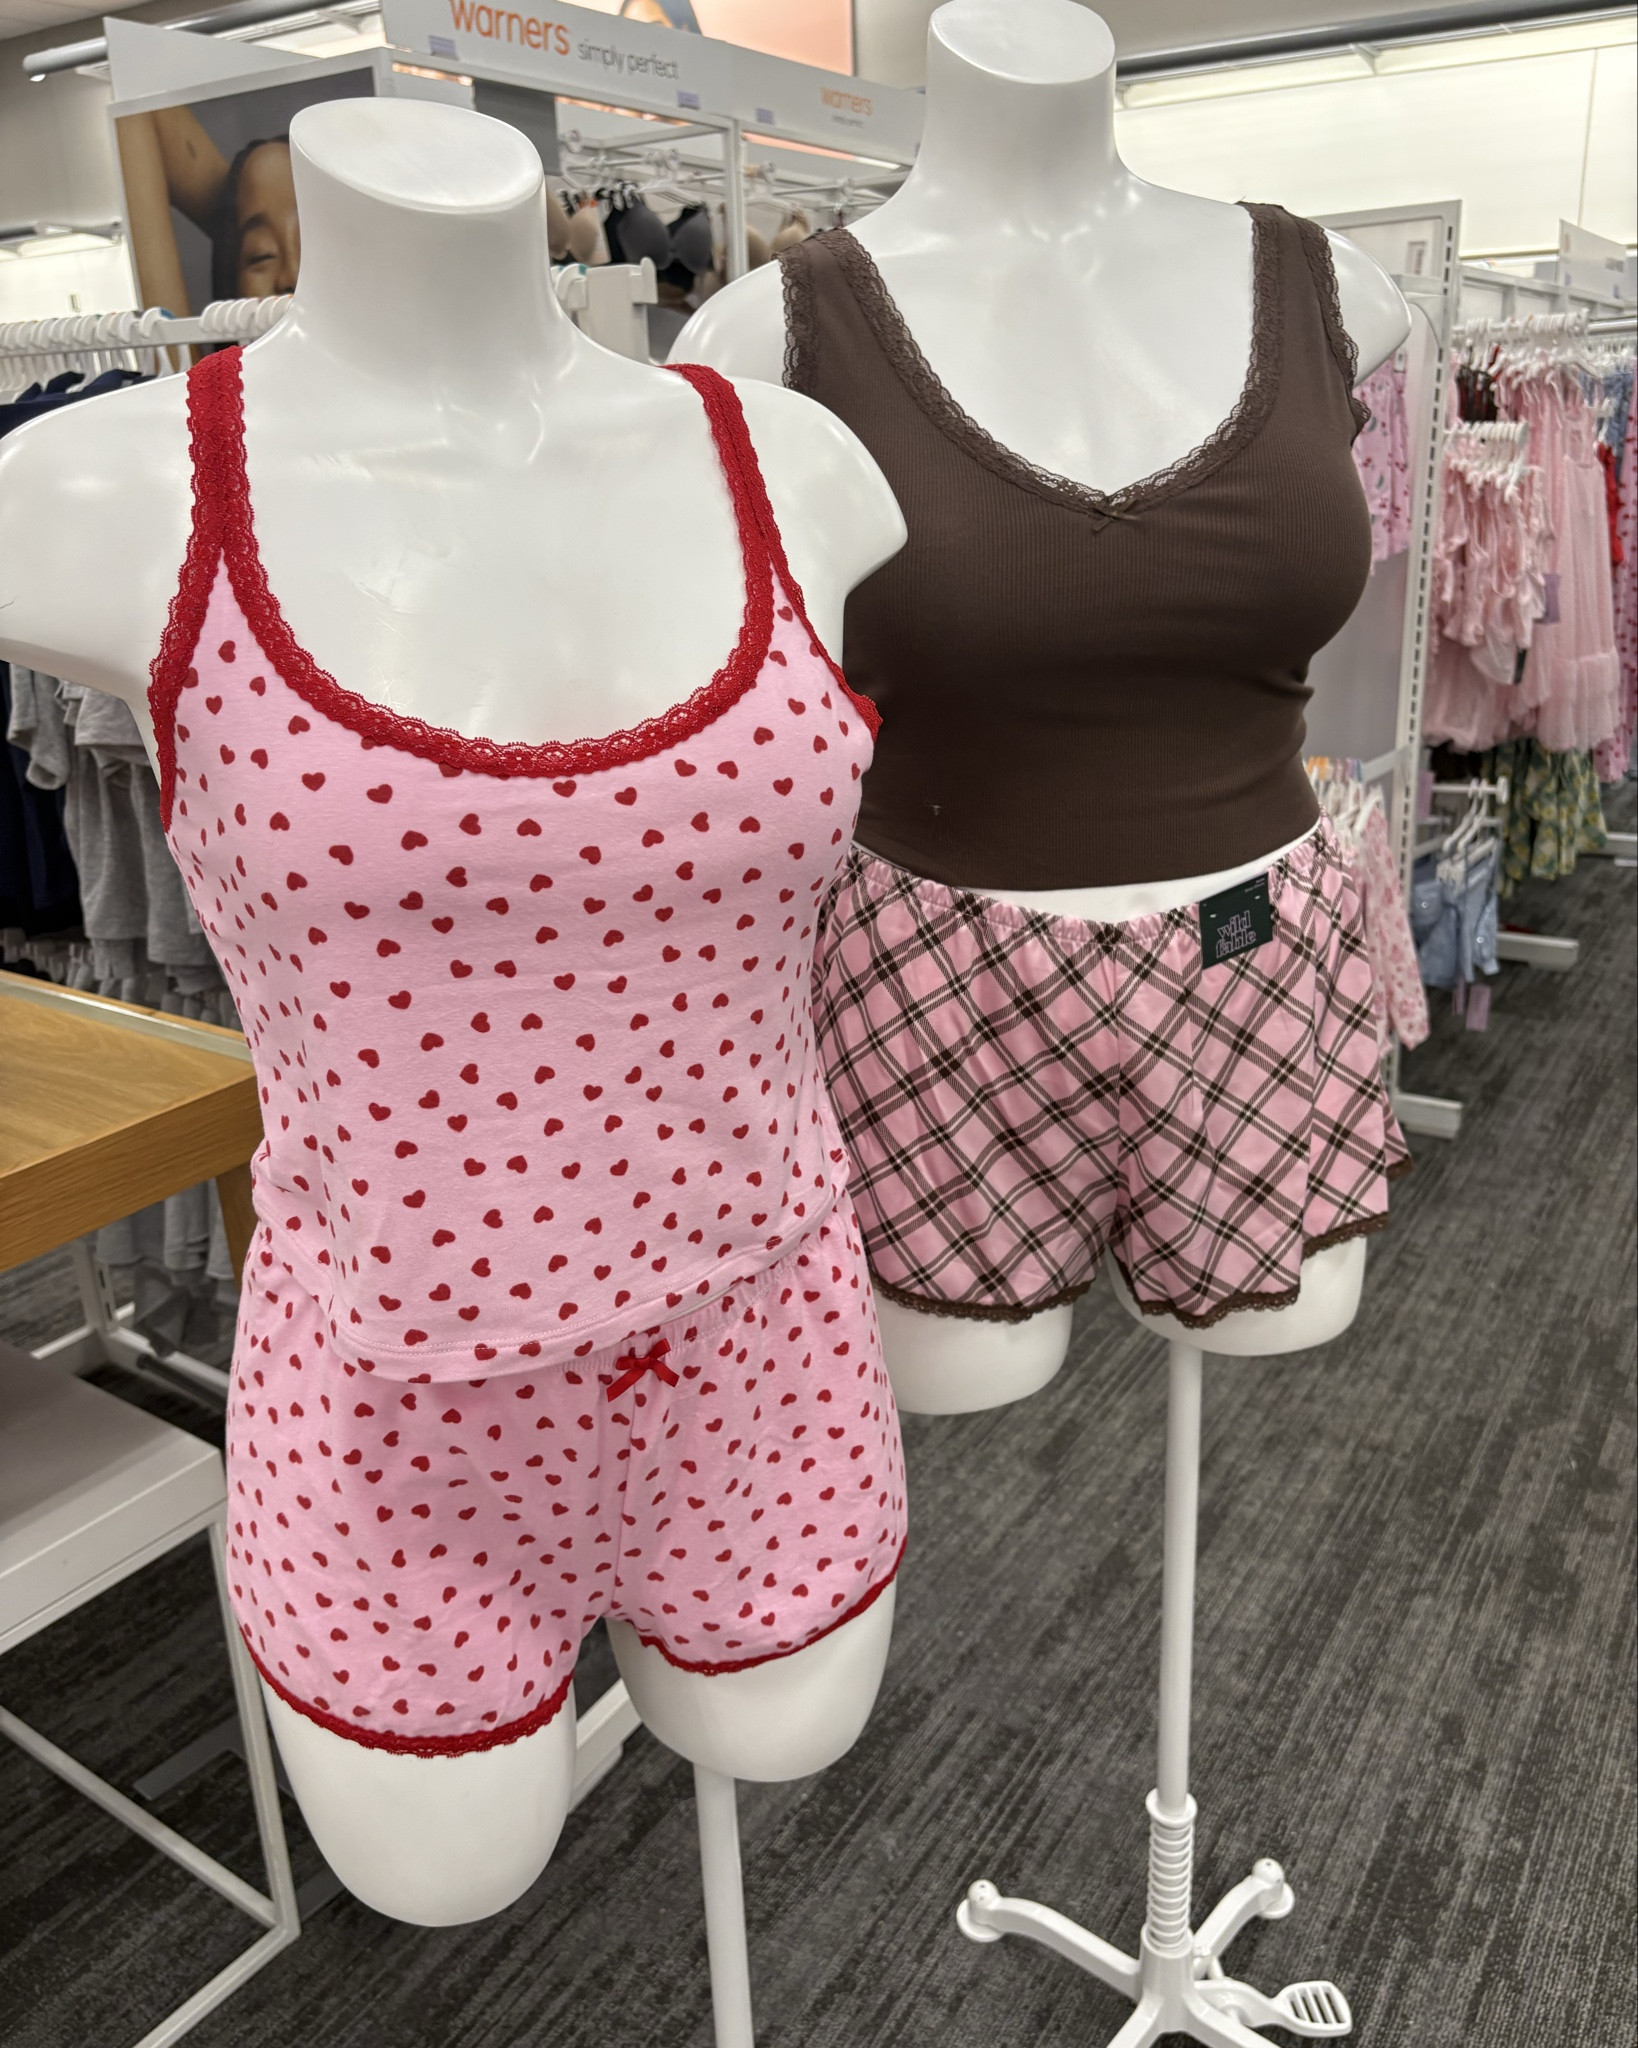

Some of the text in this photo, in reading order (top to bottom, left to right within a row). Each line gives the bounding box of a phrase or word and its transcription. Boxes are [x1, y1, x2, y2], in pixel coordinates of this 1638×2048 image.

[577, 38, 625, 75] simply
[626, 52, 680, 81] perfect
[1217, 909, 1252, 938] wild
[1215, 929, 1257, 959] fable
